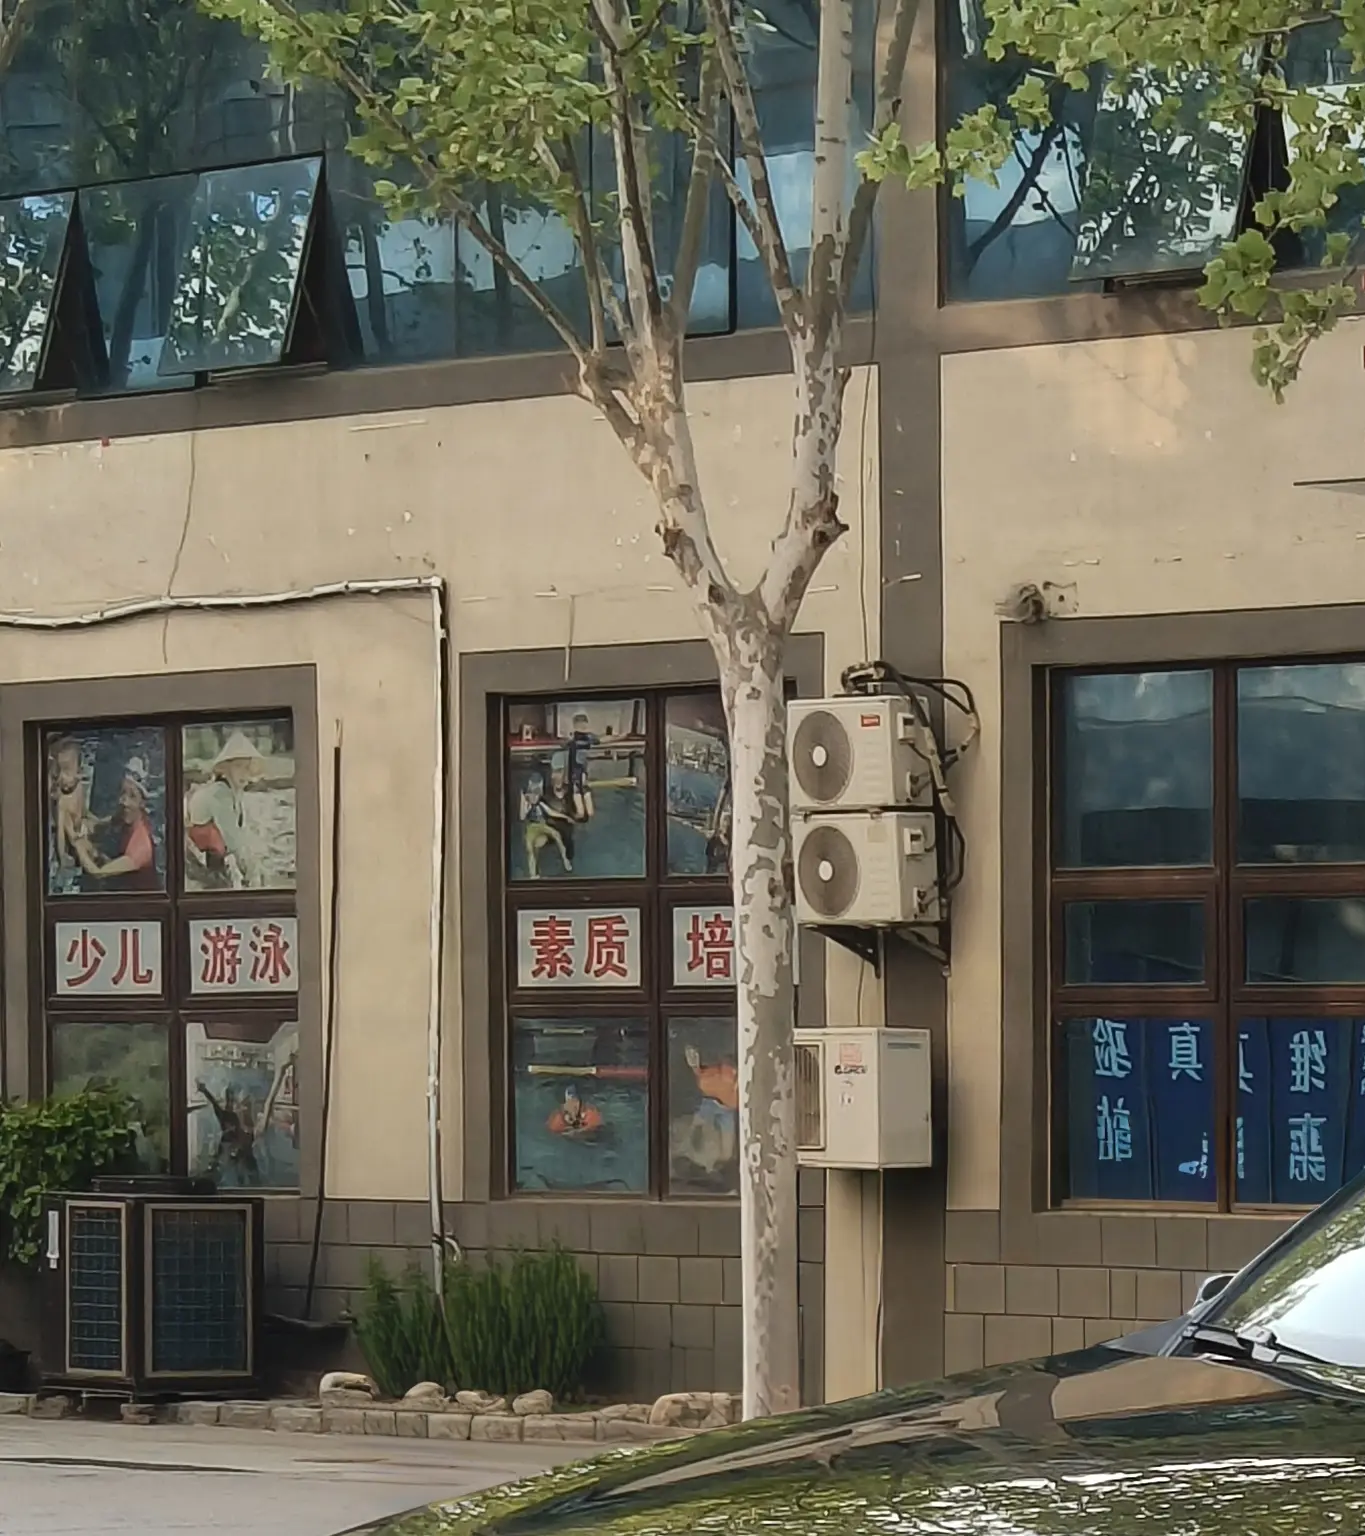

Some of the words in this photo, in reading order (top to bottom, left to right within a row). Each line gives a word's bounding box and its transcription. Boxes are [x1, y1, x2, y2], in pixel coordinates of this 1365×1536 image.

[67, 928, 153, 987] 少儿
[200, 923, 292, 984] 游泳
[530, 914, 629, 978] 素质
